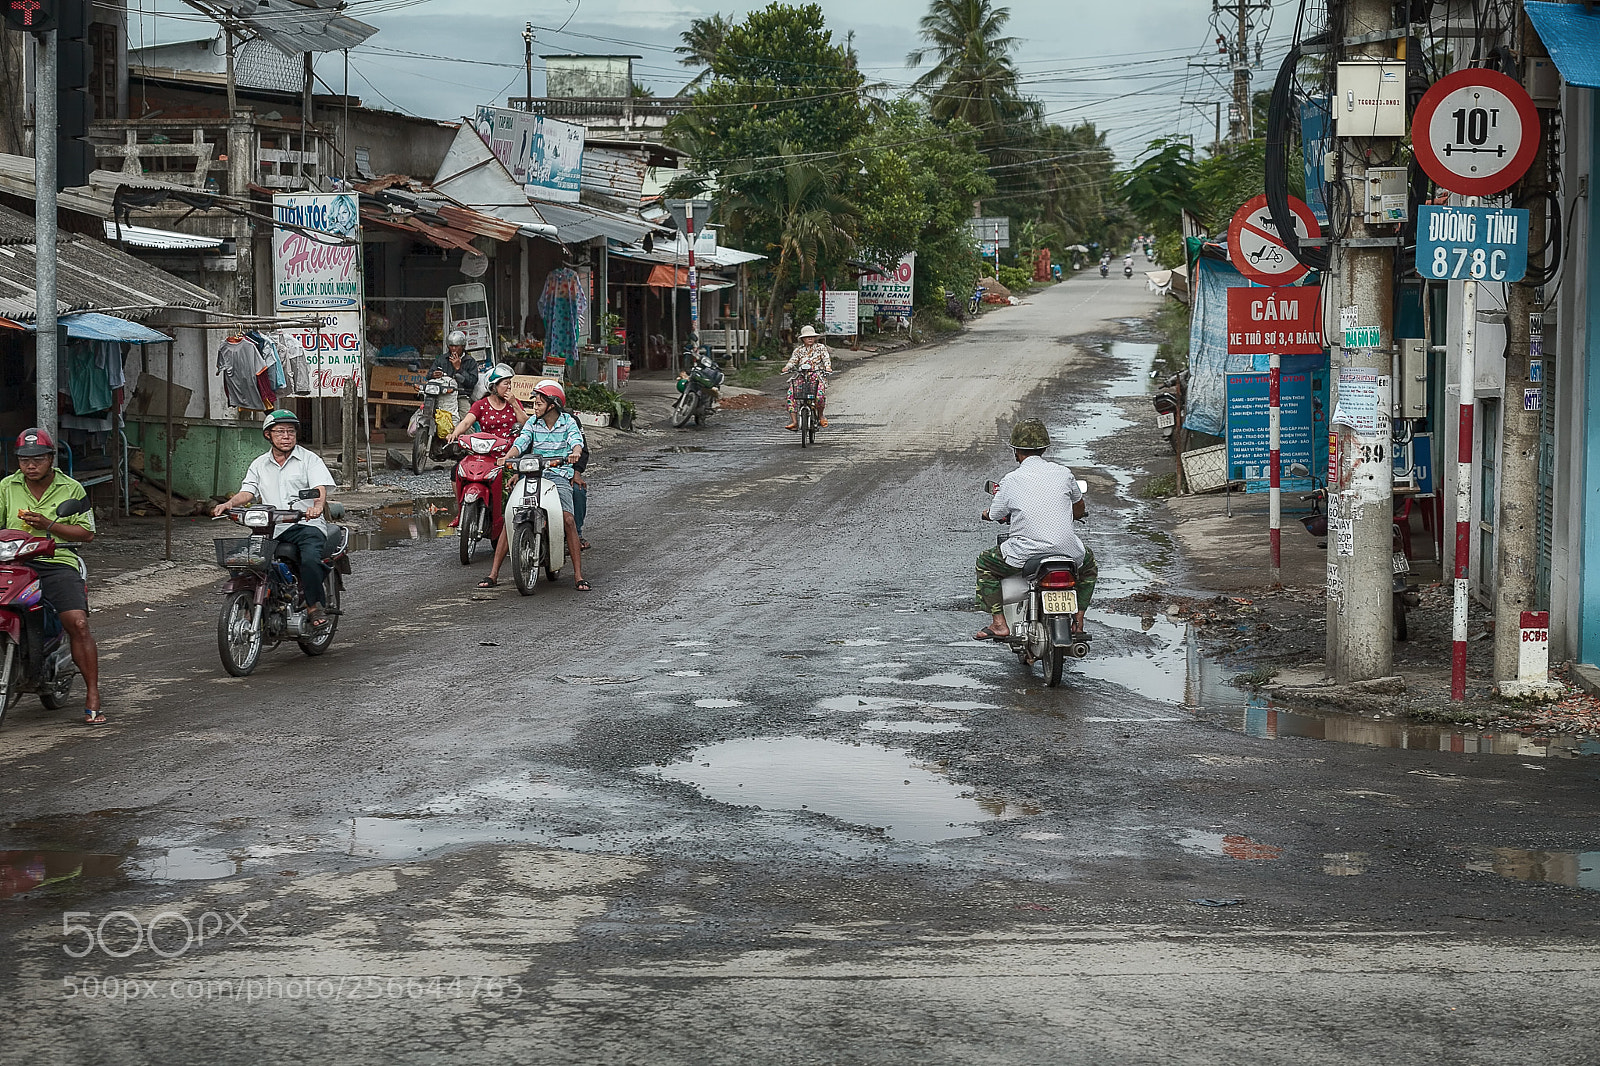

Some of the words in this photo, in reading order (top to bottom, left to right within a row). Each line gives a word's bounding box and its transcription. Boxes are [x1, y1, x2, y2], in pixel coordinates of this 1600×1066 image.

[1431, 246, 1506, 281] 878C
[1251, 292, 1299, 321] CẤM
[1230, 333, 1242, 345] XE
[1245, 330, 1261, 345] THÔ
[1279, 332, 1294, 347] 3,4
[1296, 330, 1320, 345] BÁNH
[1048, 602, 1072, 612] 9881
